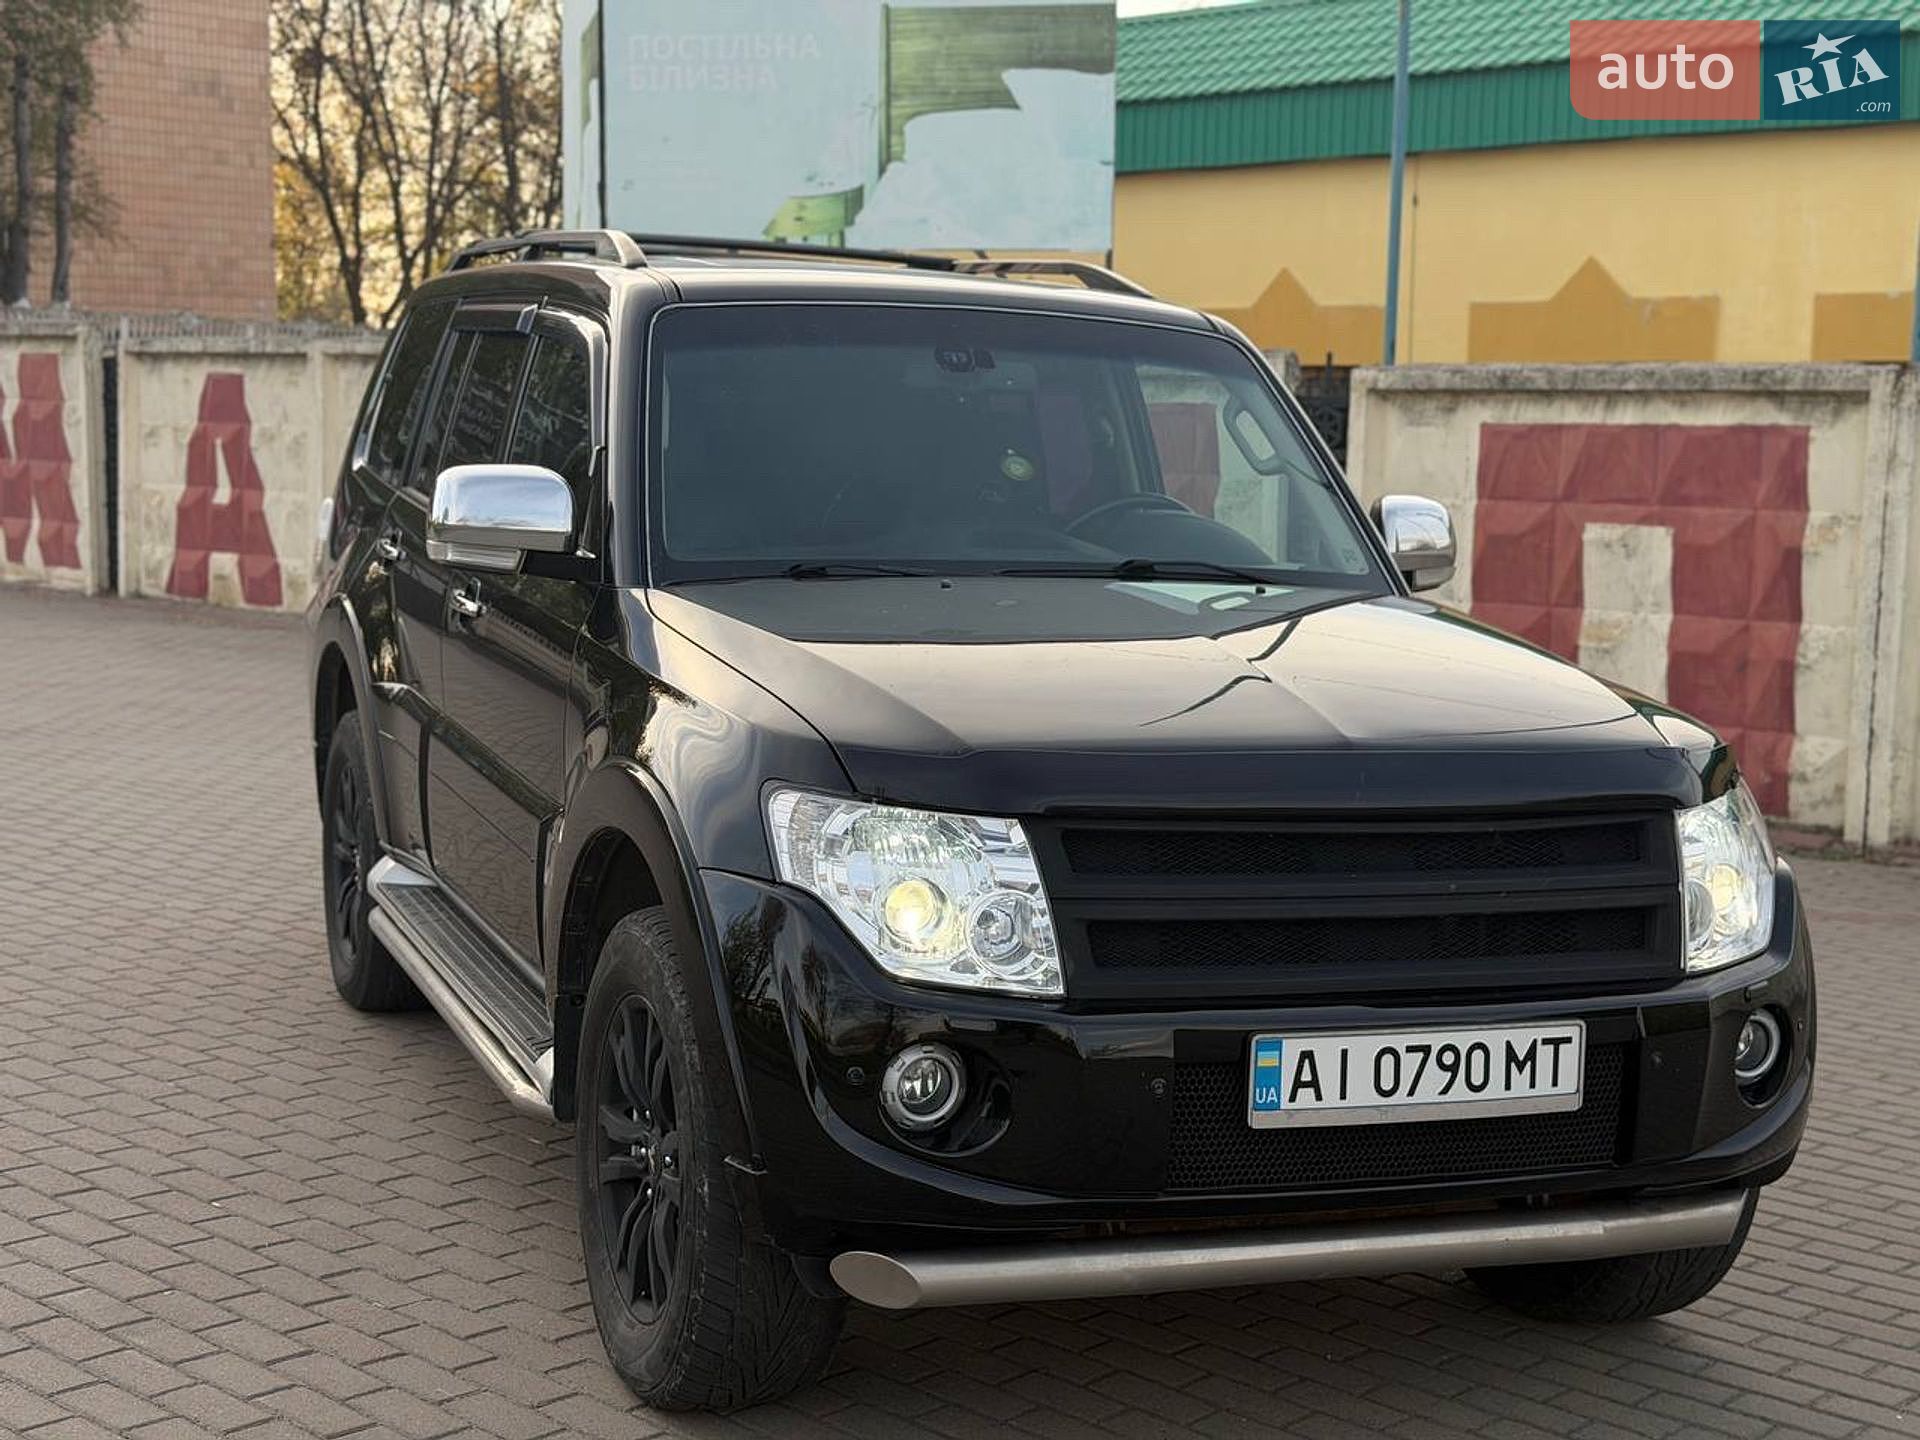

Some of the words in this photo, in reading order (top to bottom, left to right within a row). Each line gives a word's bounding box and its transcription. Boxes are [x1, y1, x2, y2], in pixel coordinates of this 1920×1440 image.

[627, 33, 821, 60] ПОСТІЛЬНА
[628, 64, 777, 91] БІЛИЗНА
[1288, 1048, 1349, 1103] AI
[1373, 1041, 1491, 1098] 0790
[1504, 1037, 1573, 1092] MT
[1255, 1088, 1278, 1104] UA
